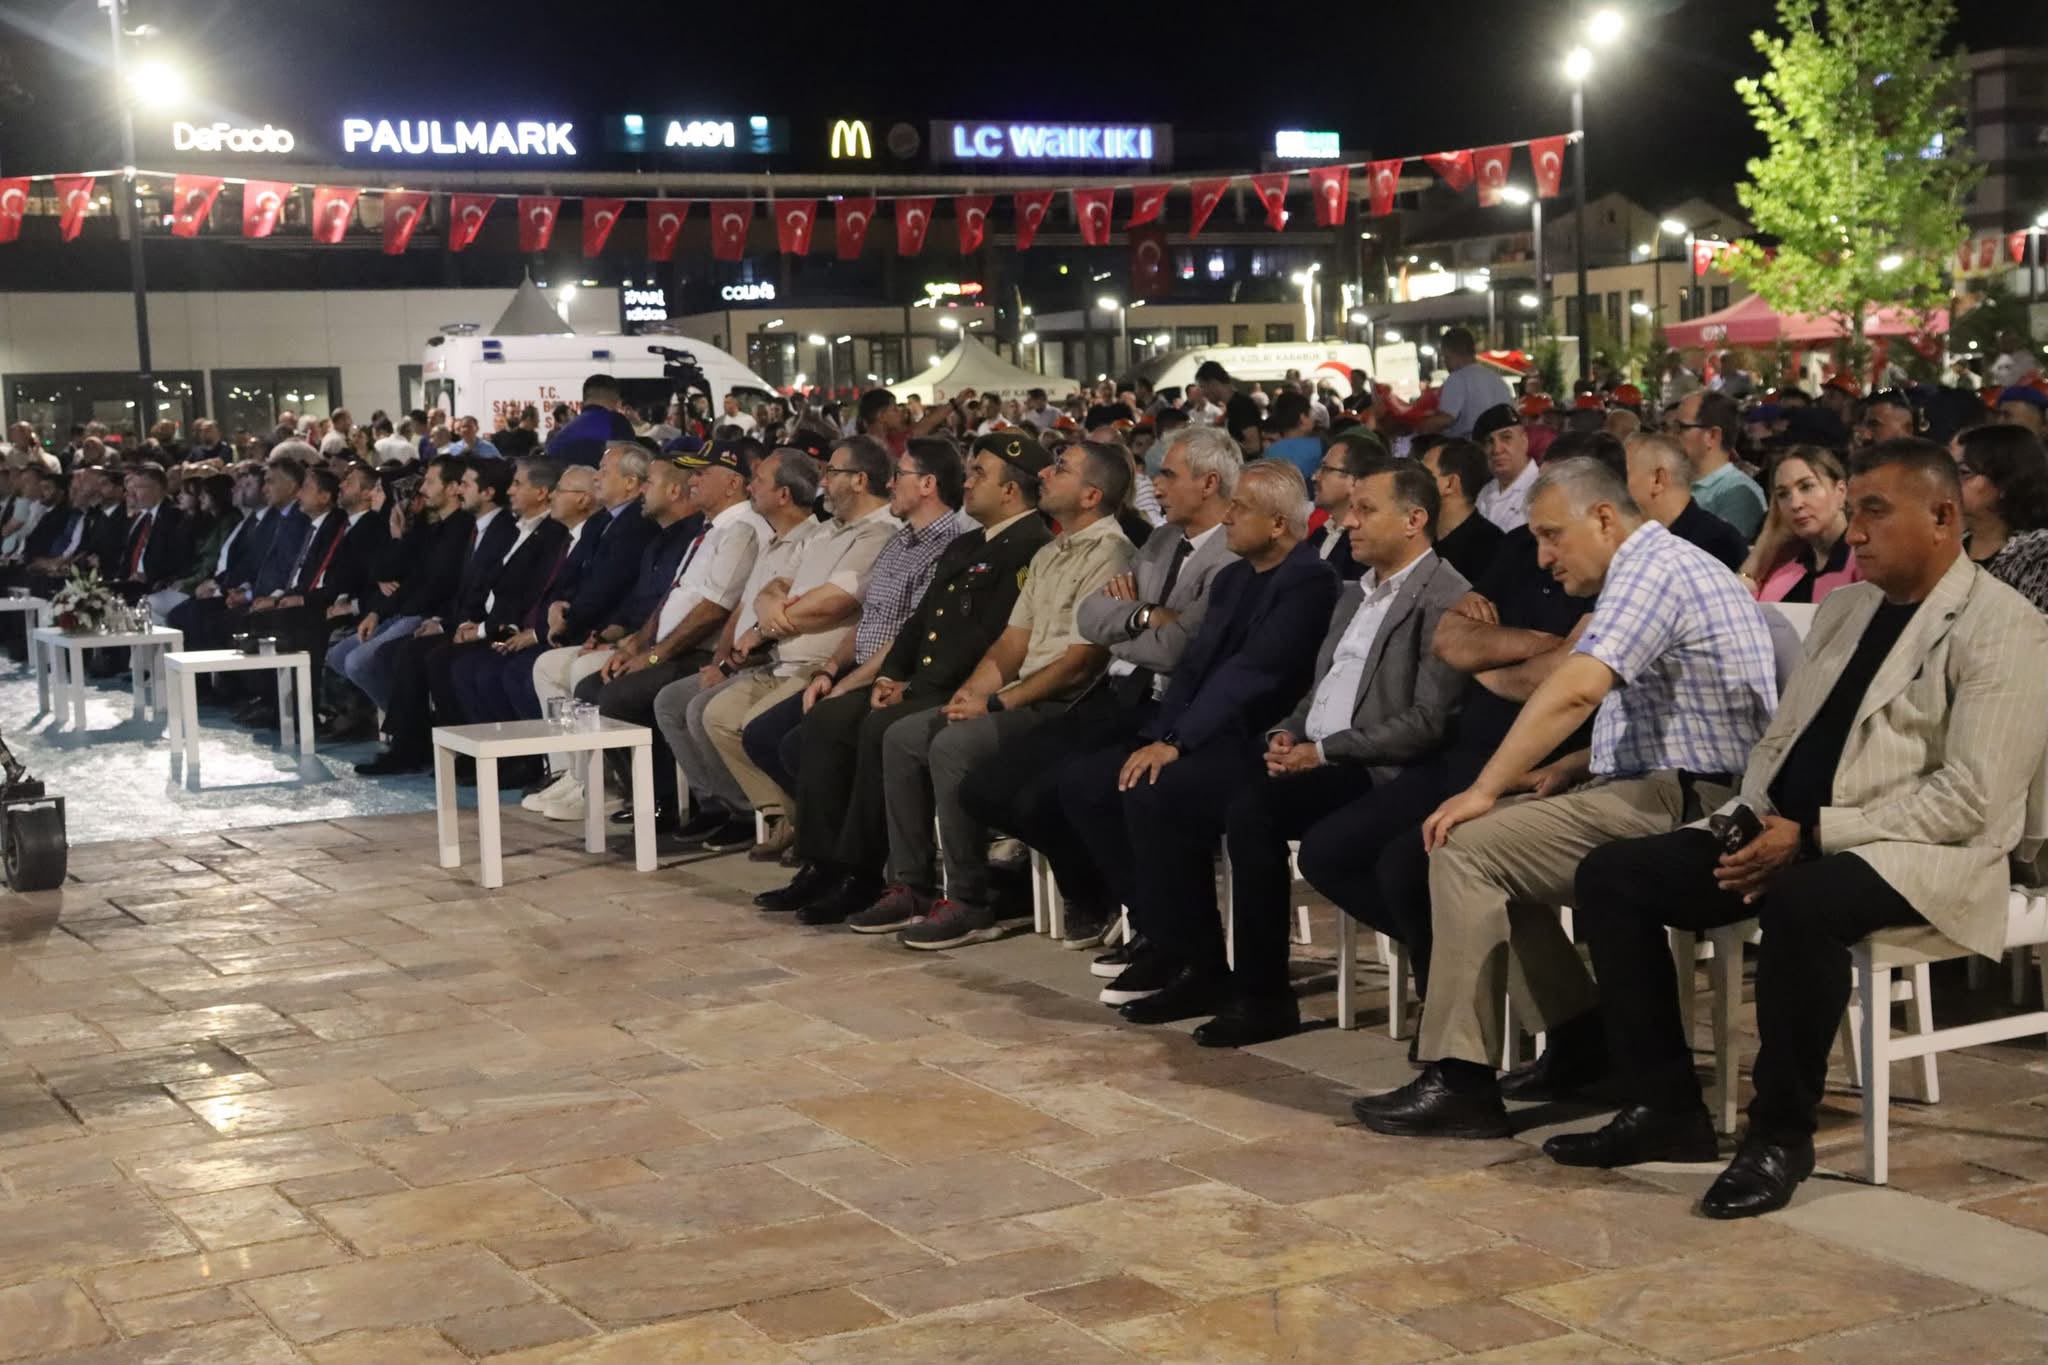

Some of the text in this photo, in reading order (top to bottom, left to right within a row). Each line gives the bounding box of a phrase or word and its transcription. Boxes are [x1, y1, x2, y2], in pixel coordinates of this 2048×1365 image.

[172, 121, 295, 153] DeFacto
[343, 119, 577, 155] PAULMARK
[953, 125, 1003, 158] LC
[538, 386, 561, 400] T.C.
